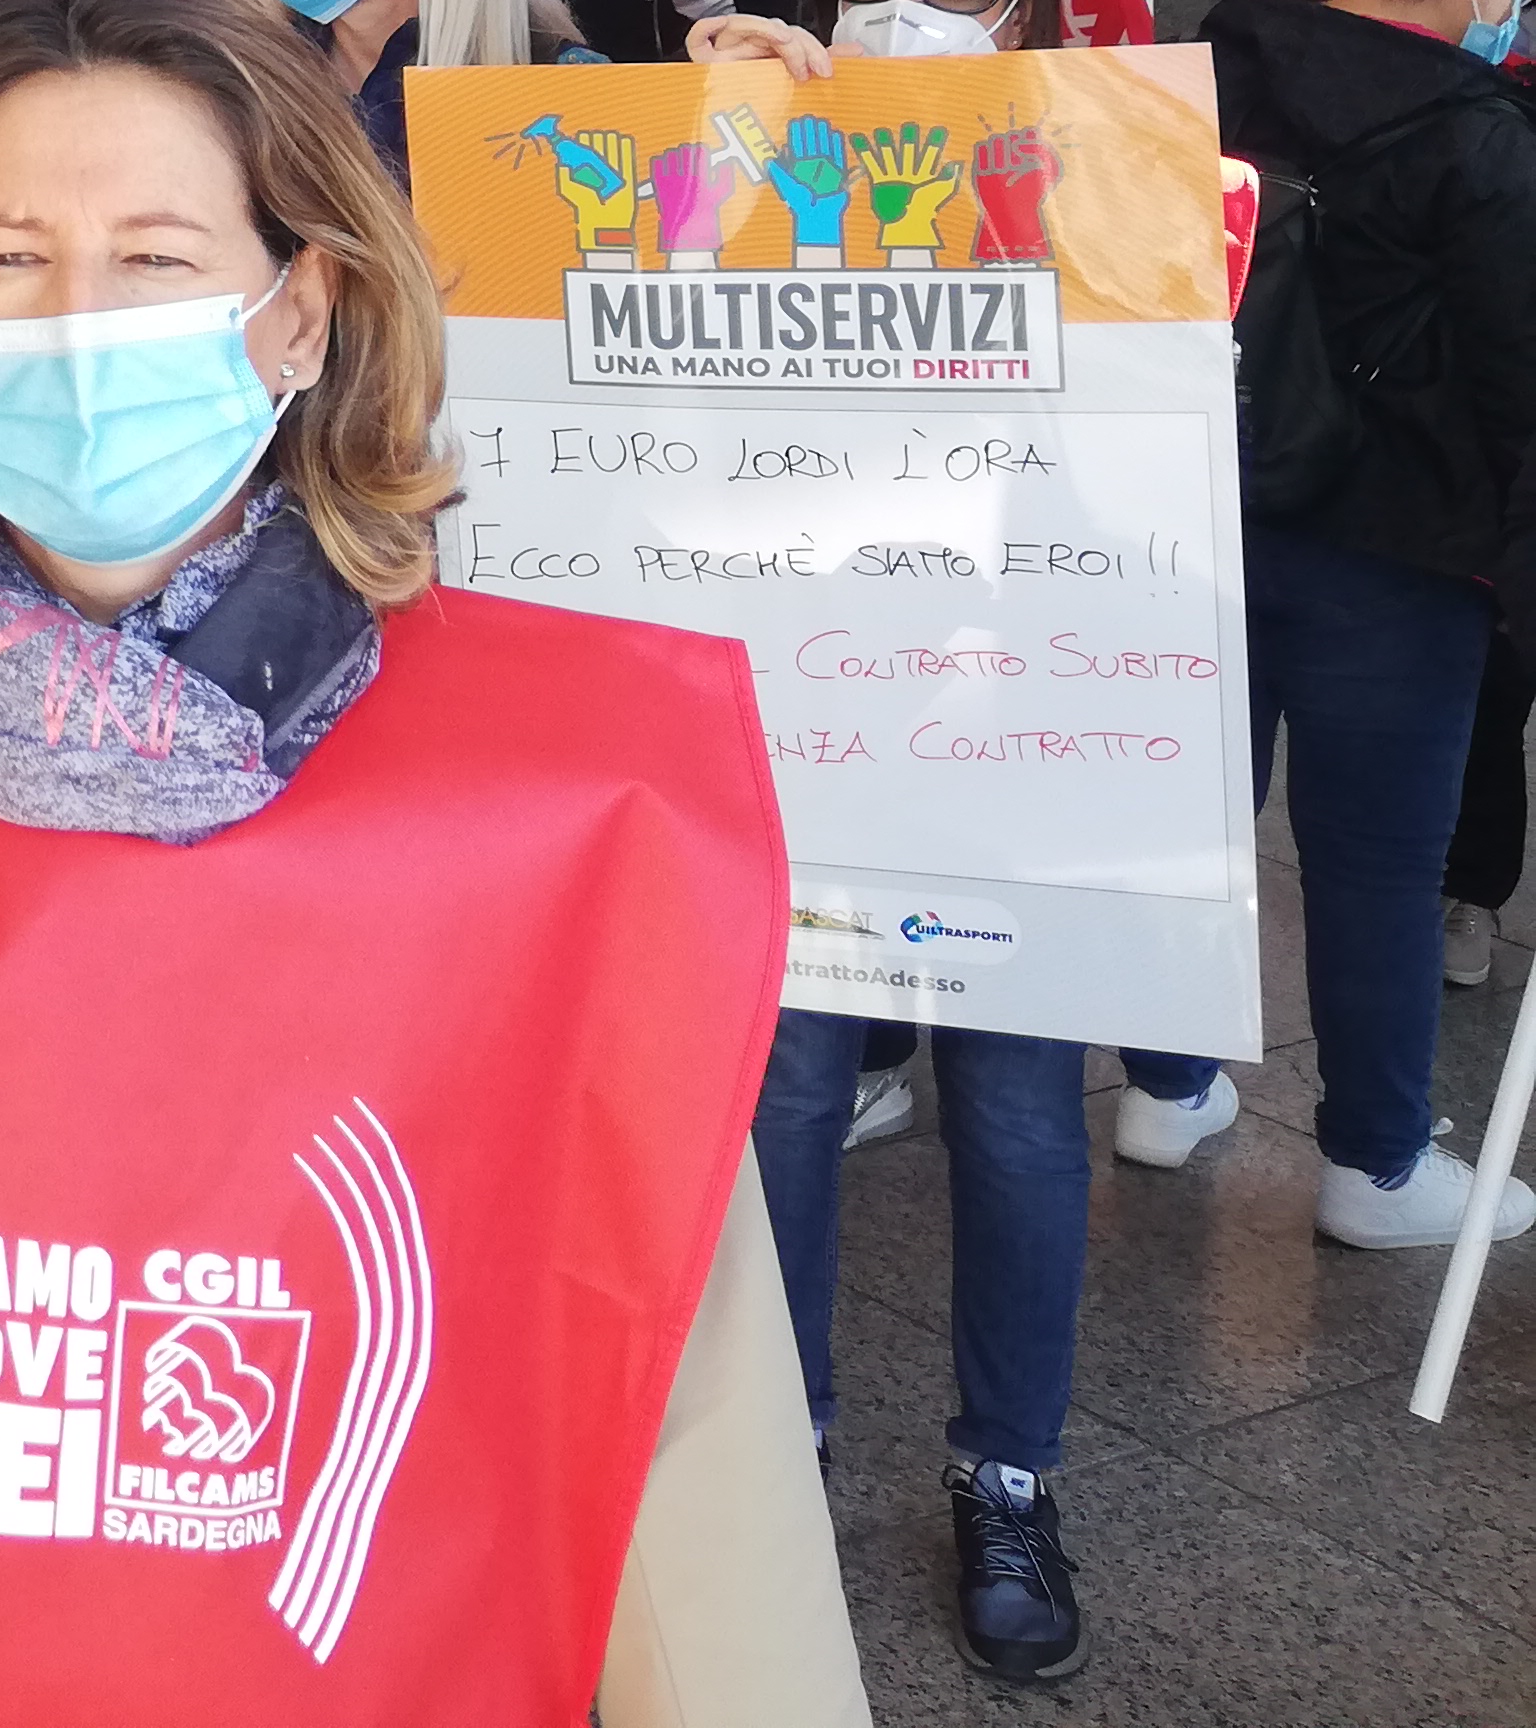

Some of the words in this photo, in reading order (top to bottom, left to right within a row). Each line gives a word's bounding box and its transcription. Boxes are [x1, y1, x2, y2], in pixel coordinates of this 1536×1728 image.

[589, 282, 1030, 352] MULTISERVIZI
[593, 354, 662, 376] UNA
[672, 356, 769, 379] MANO
[781, 356, 813, 379] AI
[822, 357, 902, 380] TUOI
[912, 357, 1030, 381] DIRITTI
[469, 426, 511, 478] 7
[550, 427, 698, 476] EURO
[727, 437, 855, 482] LORDI
[468, 523, 601, 584] ECCO
[851, 544, 976, 579] SIAMO
[795, 628, 1027, 680] CONTRATTO
[1048, 631, 1220, 680] SUBITO
[909, 720, 1181, 762] CONTRATTO
[791, 905, 874, 931] SASCAT
[787, 959, 966, 994] trattoAdesso
[142, 1248, 291, 1310] CGIL
[118, 1463, 276, 1506] FILCAMS
[101, 1509, 283, 1552] SARDEGNA
